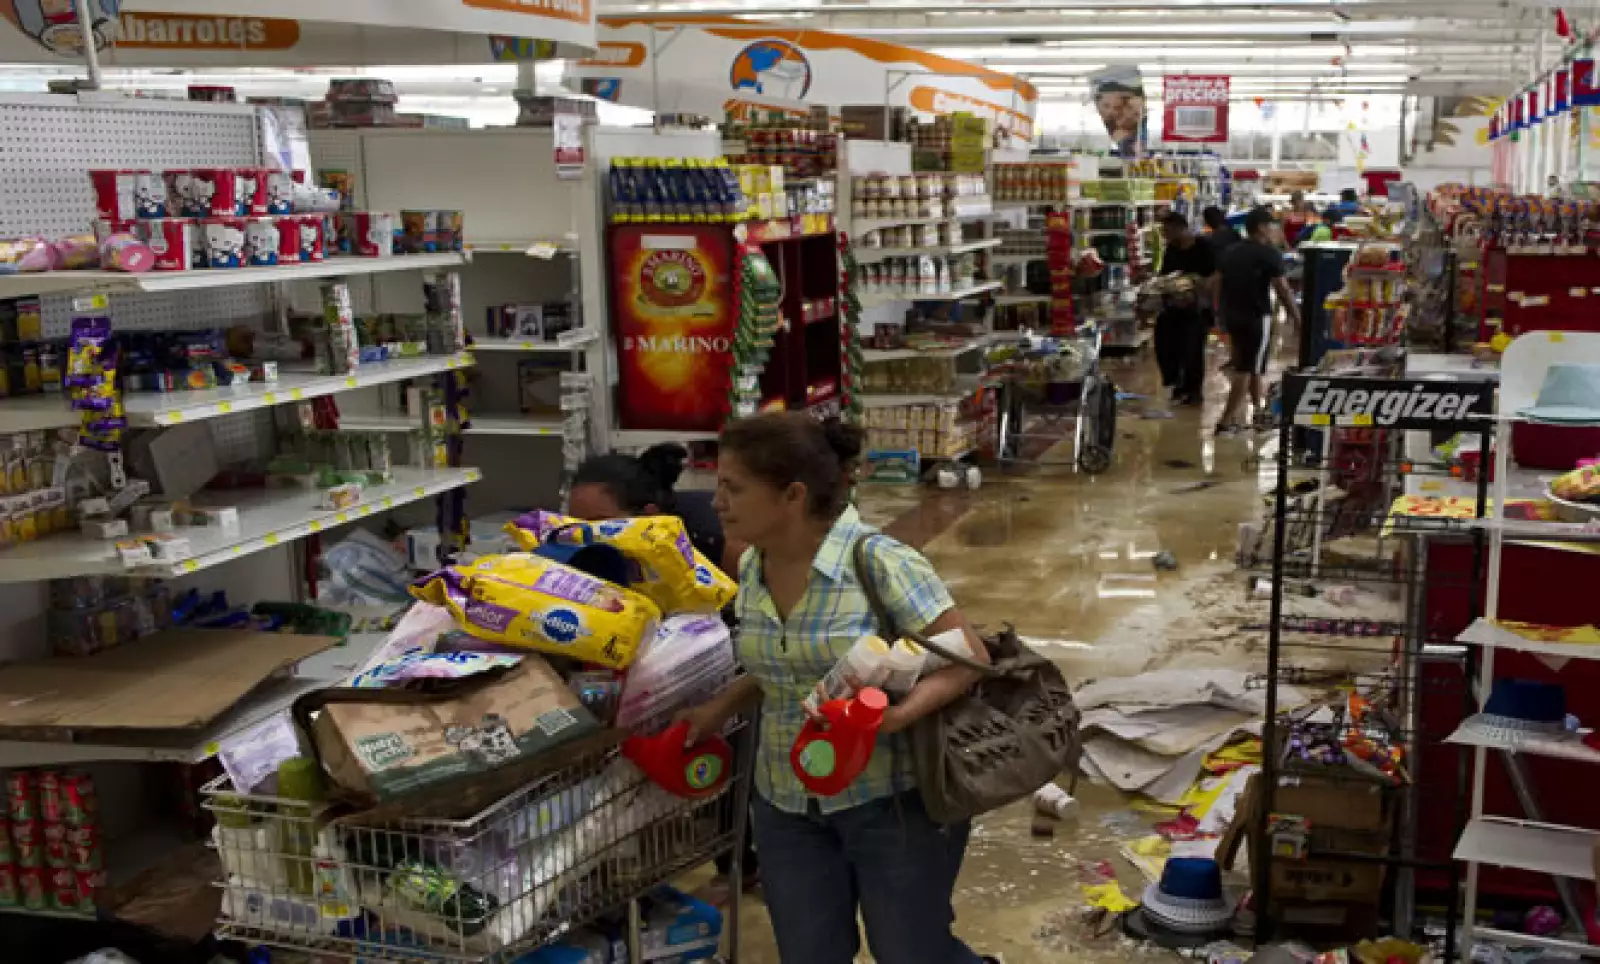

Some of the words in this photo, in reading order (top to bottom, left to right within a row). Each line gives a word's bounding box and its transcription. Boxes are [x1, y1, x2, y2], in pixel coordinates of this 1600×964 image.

[1165, 88, 1228, 105] precios
[637, 335, 729, 353] MARINO
[1296, 380, 1480, 425] Energizer
